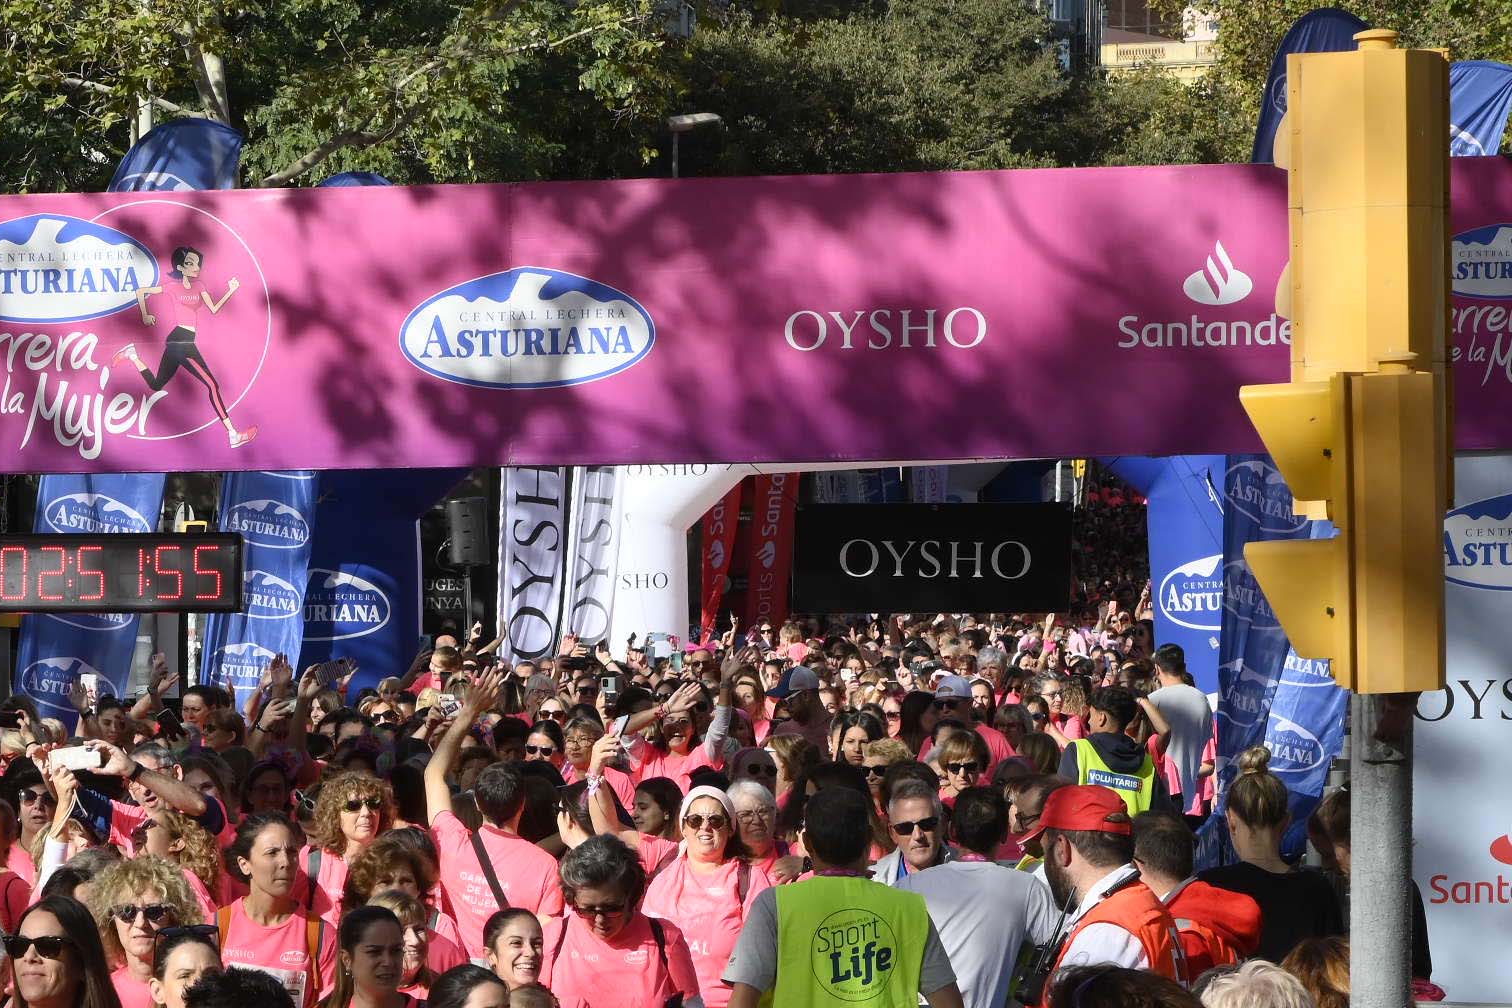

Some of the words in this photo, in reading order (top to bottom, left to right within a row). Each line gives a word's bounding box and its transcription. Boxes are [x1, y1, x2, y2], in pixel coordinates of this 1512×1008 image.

[62, 250, 135, 262] LECHERA
[459, 309, 539, 323] CENTRAL
[546, 308, 627, 321] LECHERA
[784, 307, 989, 351] OYSHO
[1118, 313, 1291, 348] Santande
[419, 313, 635, 360] ASTURIANA
[1467, 334, 1486, 362] la
[0, 375, 25, 415] la
[20, 366, 169, 460] Mujer
[762, 473, 786, 537] Santa
[229, 511, 304, 542] ASTURIANA
[839, 538, 1032, 580] OYSHO
[621, 572, 669, 591] SHO
[242, 592, 297, 612] URIANA
[426, 597, 464, 610] NYA
[1165, 583, 1223, 612] ASTU
[303, 604, 381, 623] URIANA
[1430, 874, 1510, 904] Sant
[817, 917, 881, 954] Sport
[829, 941, 892, 985] Life
